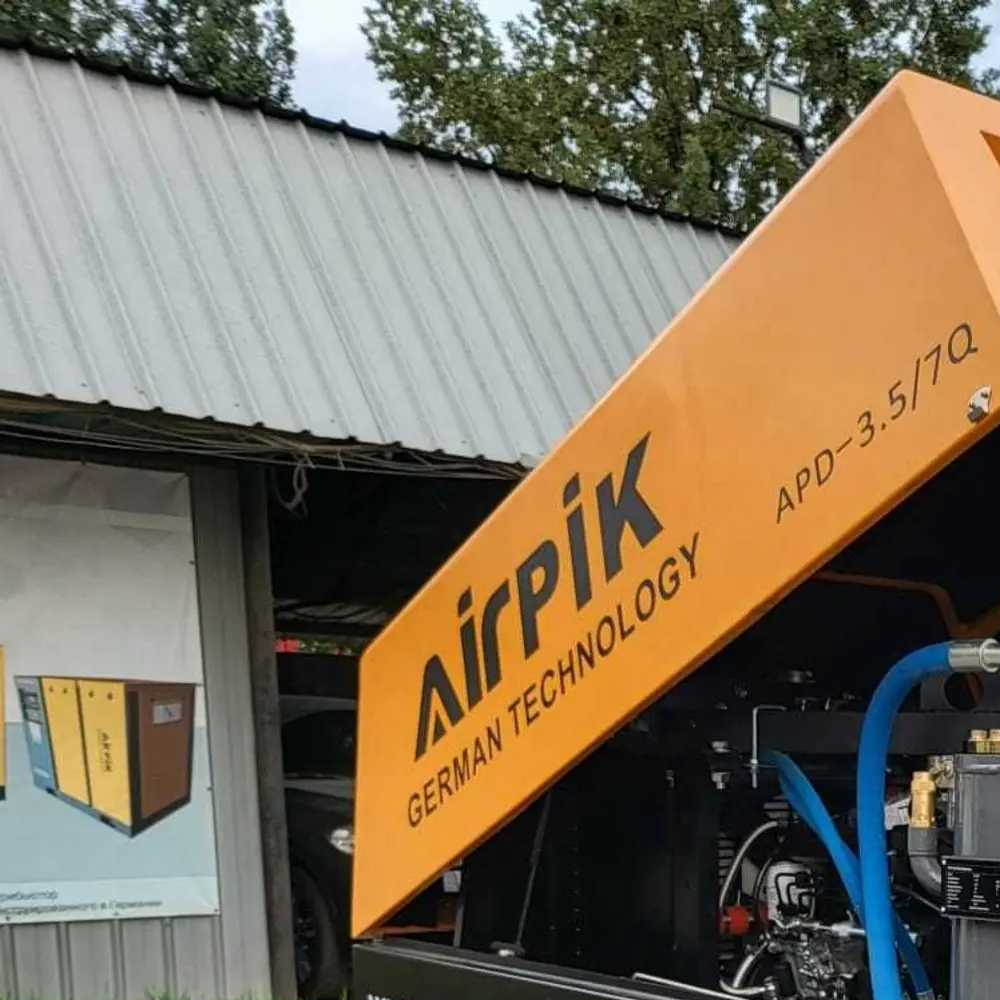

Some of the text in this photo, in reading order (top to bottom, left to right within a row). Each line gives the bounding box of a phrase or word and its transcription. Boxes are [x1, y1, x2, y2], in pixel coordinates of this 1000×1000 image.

[776, 323, 978, 525] APD-3.5/7Q
[407, 531, 700, 828] GERMAN TECHNOLOGY
